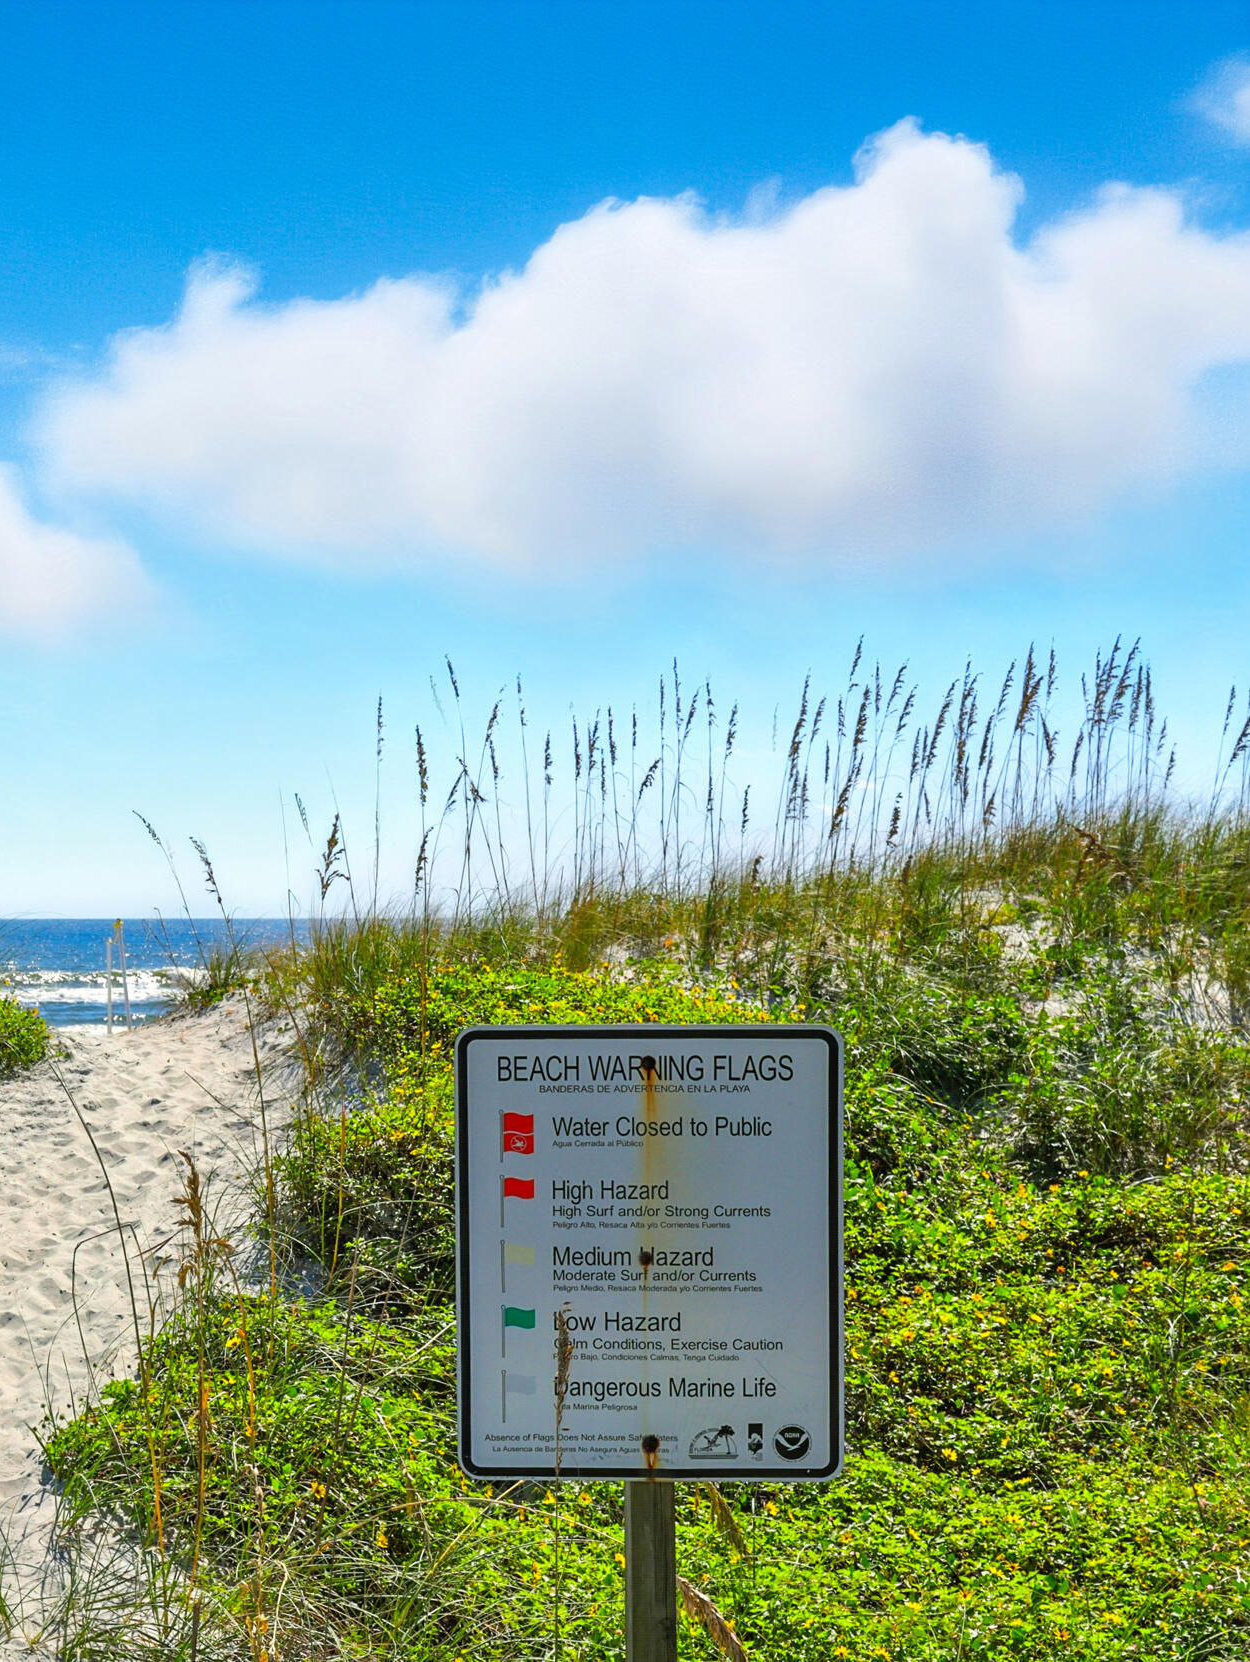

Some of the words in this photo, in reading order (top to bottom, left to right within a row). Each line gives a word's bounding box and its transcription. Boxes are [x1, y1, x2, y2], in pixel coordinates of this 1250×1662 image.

[497, 1055, 580, 1082] BEACH
[588, 1055, 704, 1081] WARNING
[713, 1055, 794, 1081] FLAGS
[539, 1084, 595, 1093] BANDERAS
[597, 1084, 612, 1093] DE
[614, 1084, 684, 1093] ADVERTENCIA
[687, 1084, 701, 1093] EN
[704, 1084, 718, 1093] LA
[720, 1084, 750, 1093] PLAYA
[552, 1116, 609, 1137] Water
[616, 1116, 684, 1137] Closed
[690, 1117, 708, 1137] to
[715, 1116, 772, 1137] Public
[552, 1140, 572, 1149] Agua
[574, 1140, 605, 1148] Cerrada
[616, 1139, 644, 1147] Público
[552, 1180, 593, 1205] High
[601, 1180, 669, 1200] Hazard
[552, 1205, 582, 1220] High
[586, 1205, 615, 1217] Surf
[619, 1205, 660, 1217] and/or
[664, 1205, 709, 1220] Strong
[712, 1205, 771, 1217] Currents
[553, 1221, 578, 1231] Peligro
[581, 1221, 596, 1230] Alto,
[598, 1221, 628, 1229] Resaca
[630, 1221, 645, 1229] Alta
[647, 1221, 658, 1230] y/o
[660, 1221, 699, 1229] Corrientes
[701, 1221, 731, 1229] Fuertes
[553, 1246, 631, 1266] Medium
[553, 1269, 616, 1281] Moderate
[620, 1269, 649, 1281] Surf
[652, 1269, 694, 1281] and/or
[699, 1269, 757, 1281] Currents
[553, 1285, 579, 1293] Peligro
[581, 1284, 605, 1293] Medio,
[638, 1284, 677, 1292] Moderada
[692, 1284, 732, 1292] Corrientes
[734, 1284, 763, 1292] Fuertes
[553, 1312, 597, 1331] Low
[604, 1312, 681, 1331] Hazard
[592, 1338, 666, 1352] Conditions,
[671, 1338, 727, 1350] Exercise
[732, 1338, 784, 1351] Caution
[601, 1353, 648, 1361] Condiciones
[683, 1354, 706, 1363] Tenga
[669, 1377, 735, 1397] Marine
[742, 1377, 777, 1397] Life
[601, 1403, 638, 1412] Peligrosa
[485, 1433, 520, 1442] Absence
[523, 1433, 531, 1441] of
[533, 1433, 555, 1443] Flags
[557, 1433, 579, 1441] Does
[581, 1433, 595, 1441] Not
[597, 1433, 625, 1442] Assure
[628, 1433, 648, 1442] Saf
[650, 1434, 678, 1442] aters
[589, 1446, 617, 1454] Asegura
[618, 1446, 640, 1454] Aguas
